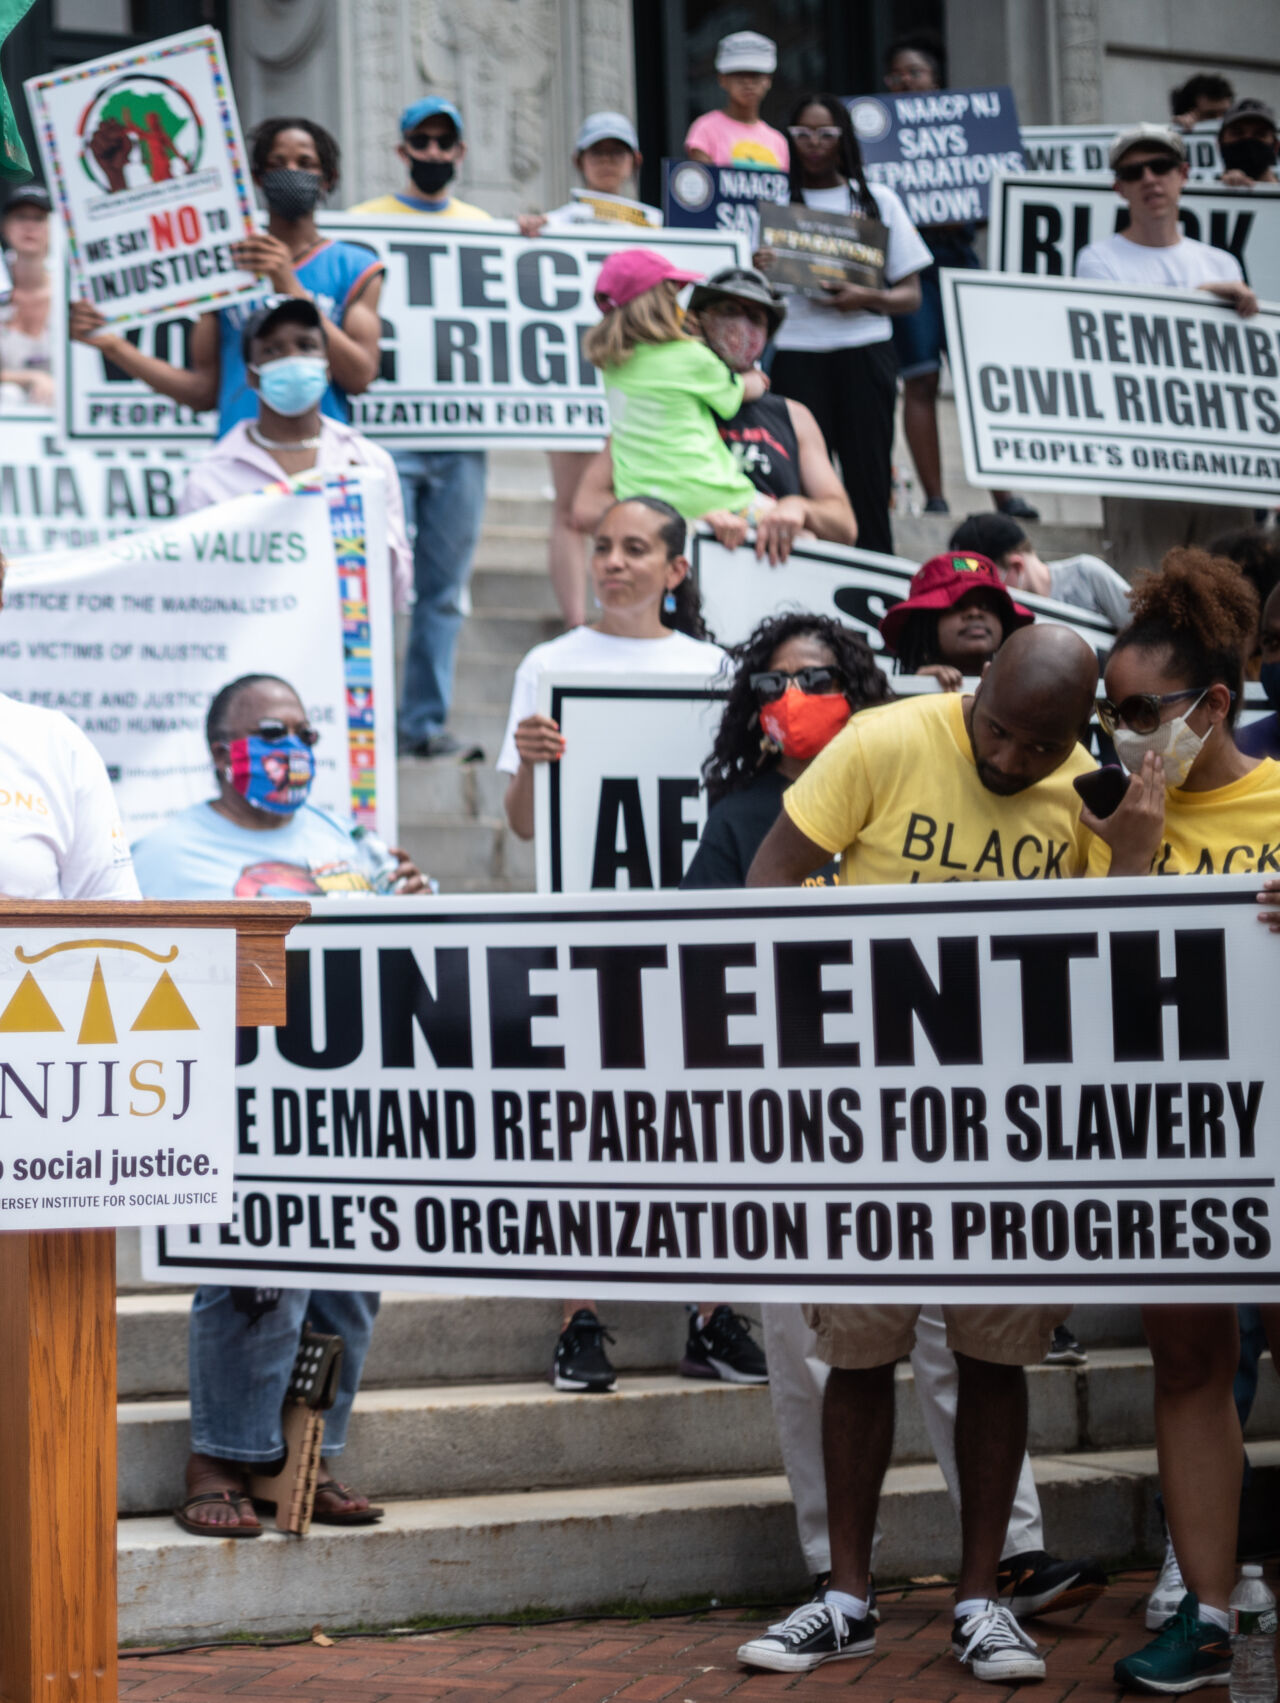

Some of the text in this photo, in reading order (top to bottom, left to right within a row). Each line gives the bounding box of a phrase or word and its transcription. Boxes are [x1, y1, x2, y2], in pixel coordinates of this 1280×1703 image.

[895, 91, 1001, 125] NAACP NJ
[897, 124, 969, 160] SAYS
[906, 187, 984, 225] NOW!
[149, 205, 202, 252] NO
[204, 207, 230, 234] TO
[496, 403, 555, 426] FOR
[978, 364, 1280, 435] CIVIL RIGHTS
[992, 437, 1124, 467] PEOPLE'S
[189, 531, 308, 564] VALUES
[76, 594, 116, 612] FOR
[122, 595, 155, 612] THE
[162, 594, 298, 615] MARGINALIZED
[27, 642, 104, 661] VICTIMS
[111, 643, 133, 660] OF
[141, 643, 229, 662] INJUSTICE
[29, 691, 78, 709] PEACE
[101, 691, 137, 709] AND
[142, 691, 212, 711] JUSTIC
[82, 716, 120, 733] AND
[901, 812, 1070, 881] BLACK
[1151, 841, 1280, 877] LACK
[236, 928, 1231, 1071] UNETEENTH
[271, 1086, 477, 1161] DEMAND
[492, 1087, 864, 1164] REPARATIONS
[880, 1085, 990, 1164] FOR
[1004, 1080, 1265, 1163] SLAVERY
[12, 1149, 102, 1182] social
[109, 1148, 219, 1186] justice.
[41, 1195, 100, 1209] INSTITUTE
[103, 1194, 126, 1207] FOR
[129, 1193, 170, 1206] SOCIAL
[172, 1191, 219, 1205] JUSTICE
[414, 1196, 809, 1262] ORGANIZATION
[825, 1200, 935, 1262] FOR
[951, 1196, 1272, 1262] PROGRESS
